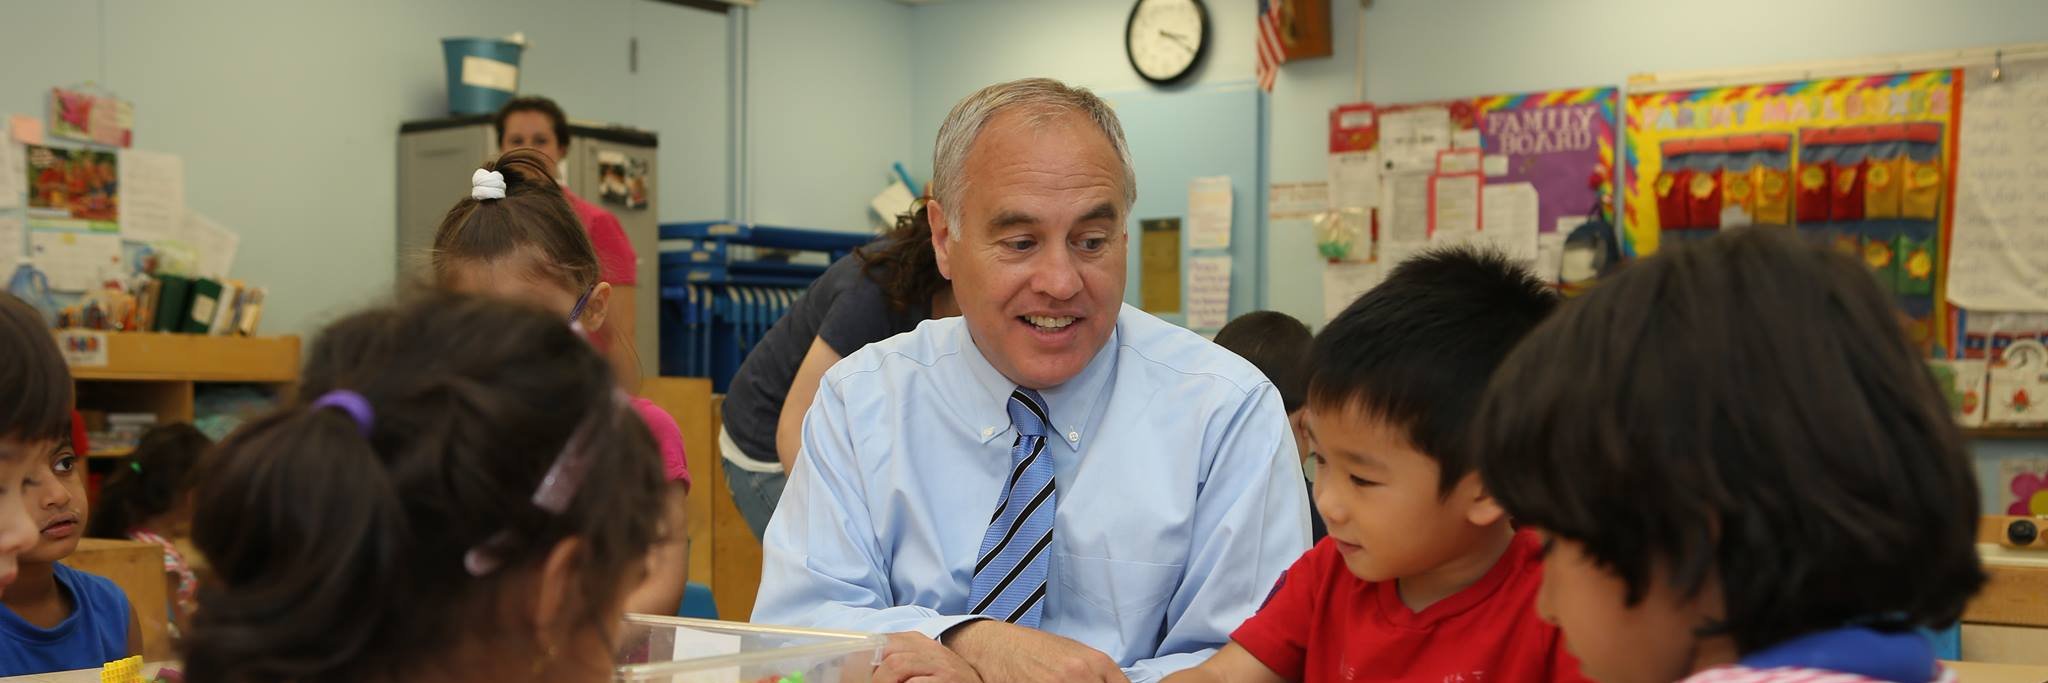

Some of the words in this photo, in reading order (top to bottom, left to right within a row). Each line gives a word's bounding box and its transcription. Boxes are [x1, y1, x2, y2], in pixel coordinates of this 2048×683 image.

[1487, 105, 1596, 136] FAMILY
[1642, 102, 1750, 131] PARENT
[1500, 130, 1592, 155] BOARD
